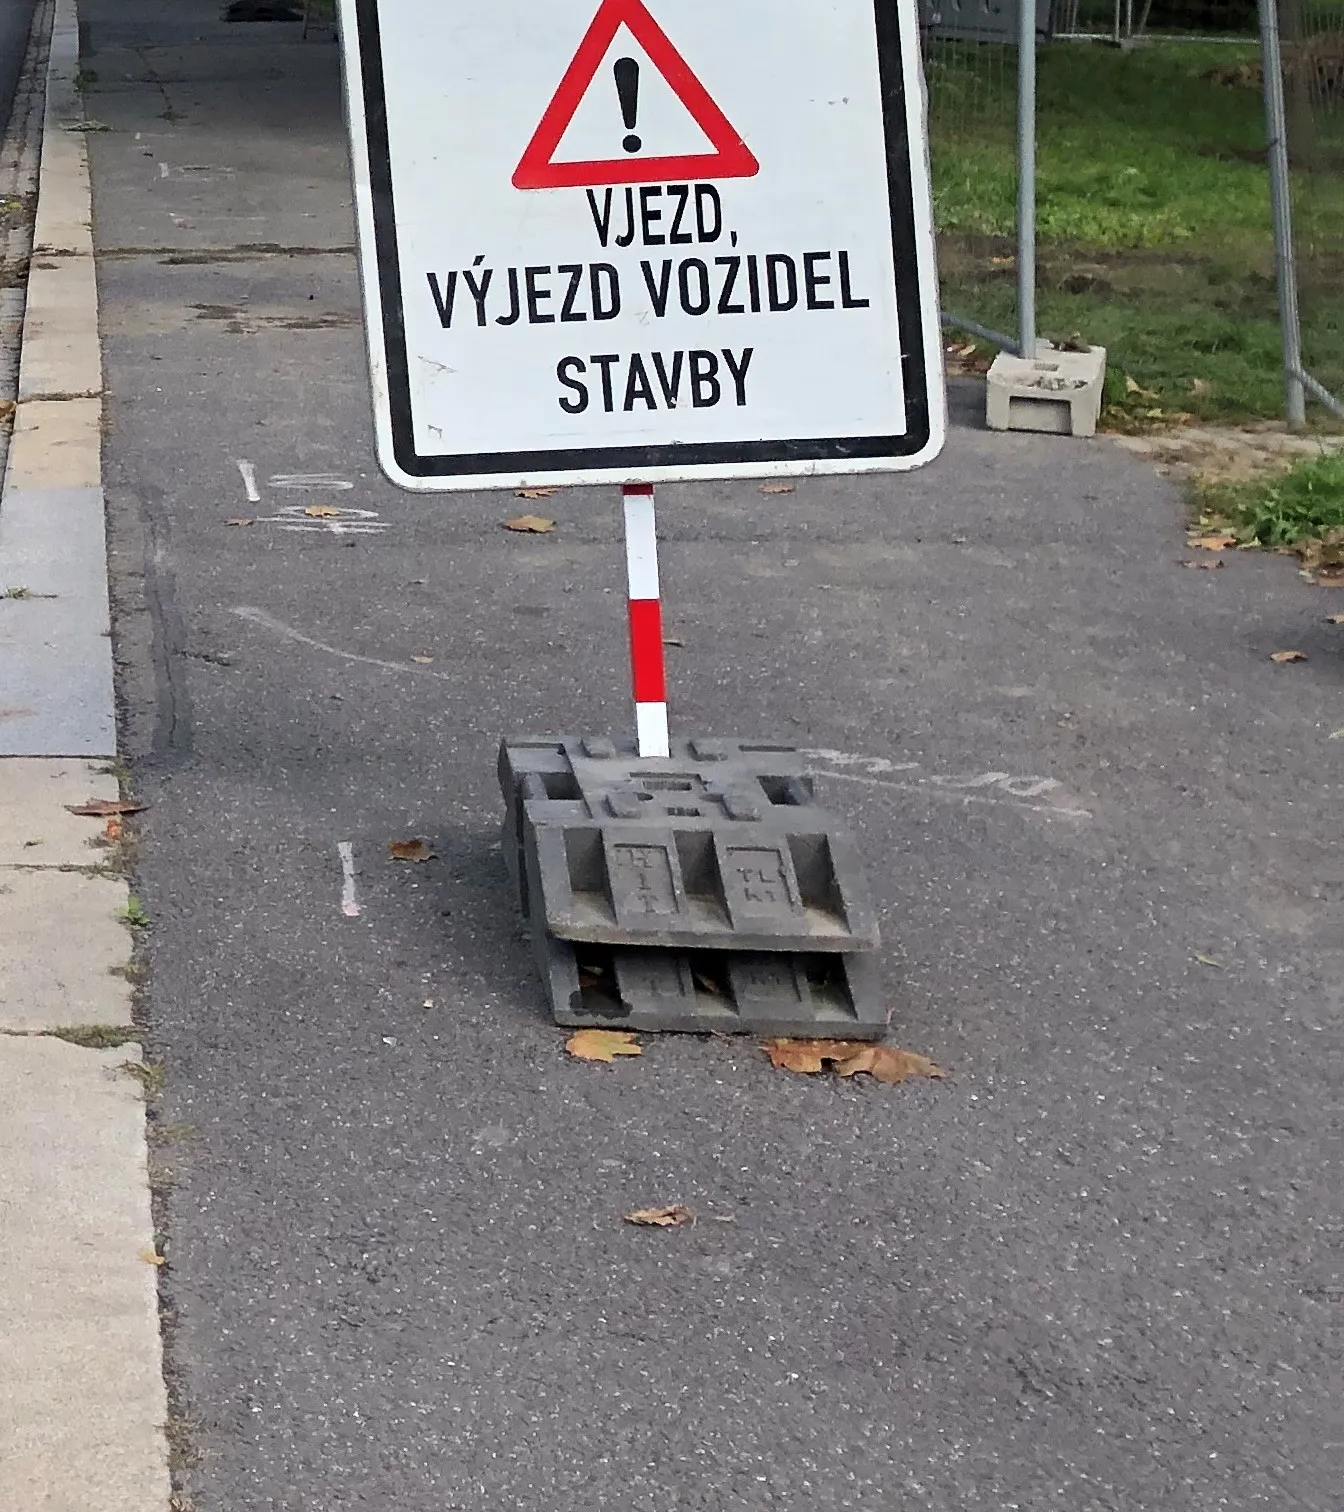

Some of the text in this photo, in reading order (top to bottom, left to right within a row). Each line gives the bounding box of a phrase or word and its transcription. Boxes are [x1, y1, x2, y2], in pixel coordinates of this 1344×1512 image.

[585, 183, 738, 248] VJEZD,
[426, 250, 870, 329] VÝJEZD VOZIDEL
[556, 347, 754, 414] STAVBY
